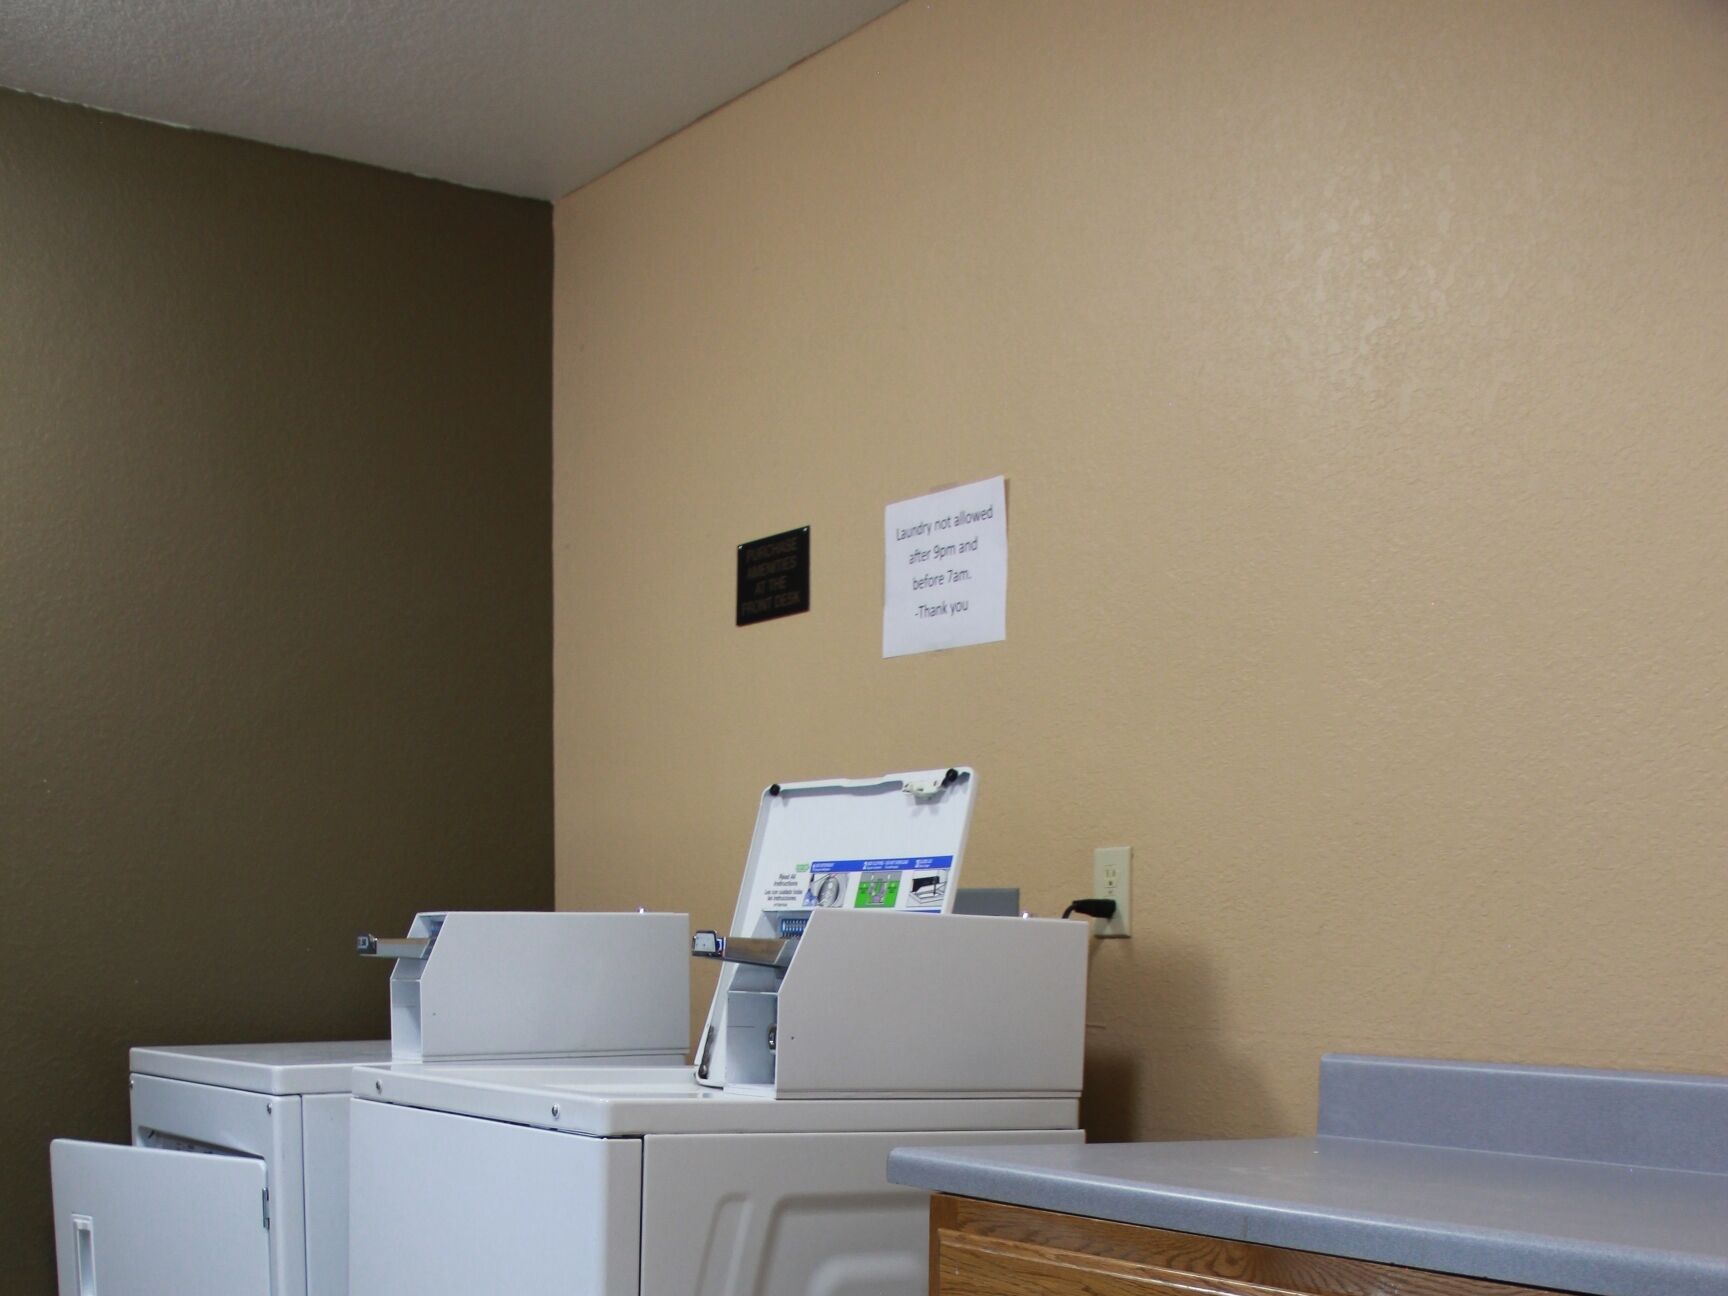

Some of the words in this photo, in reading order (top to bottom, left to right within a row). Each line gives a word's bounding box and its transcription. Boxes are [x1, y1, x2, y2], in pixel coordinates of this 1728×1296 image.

[896, 522, 931, 541] Laundry
[934, 516, 952, 531] not
[954, 505, 993, 526] allowed
[908, 549, 931, 565] after
[933, 544, 956, 560] 9pm
[959, 537, 978, 553] and
[912, 574, 944, 590] before
[950, 600, 969, 616] you
